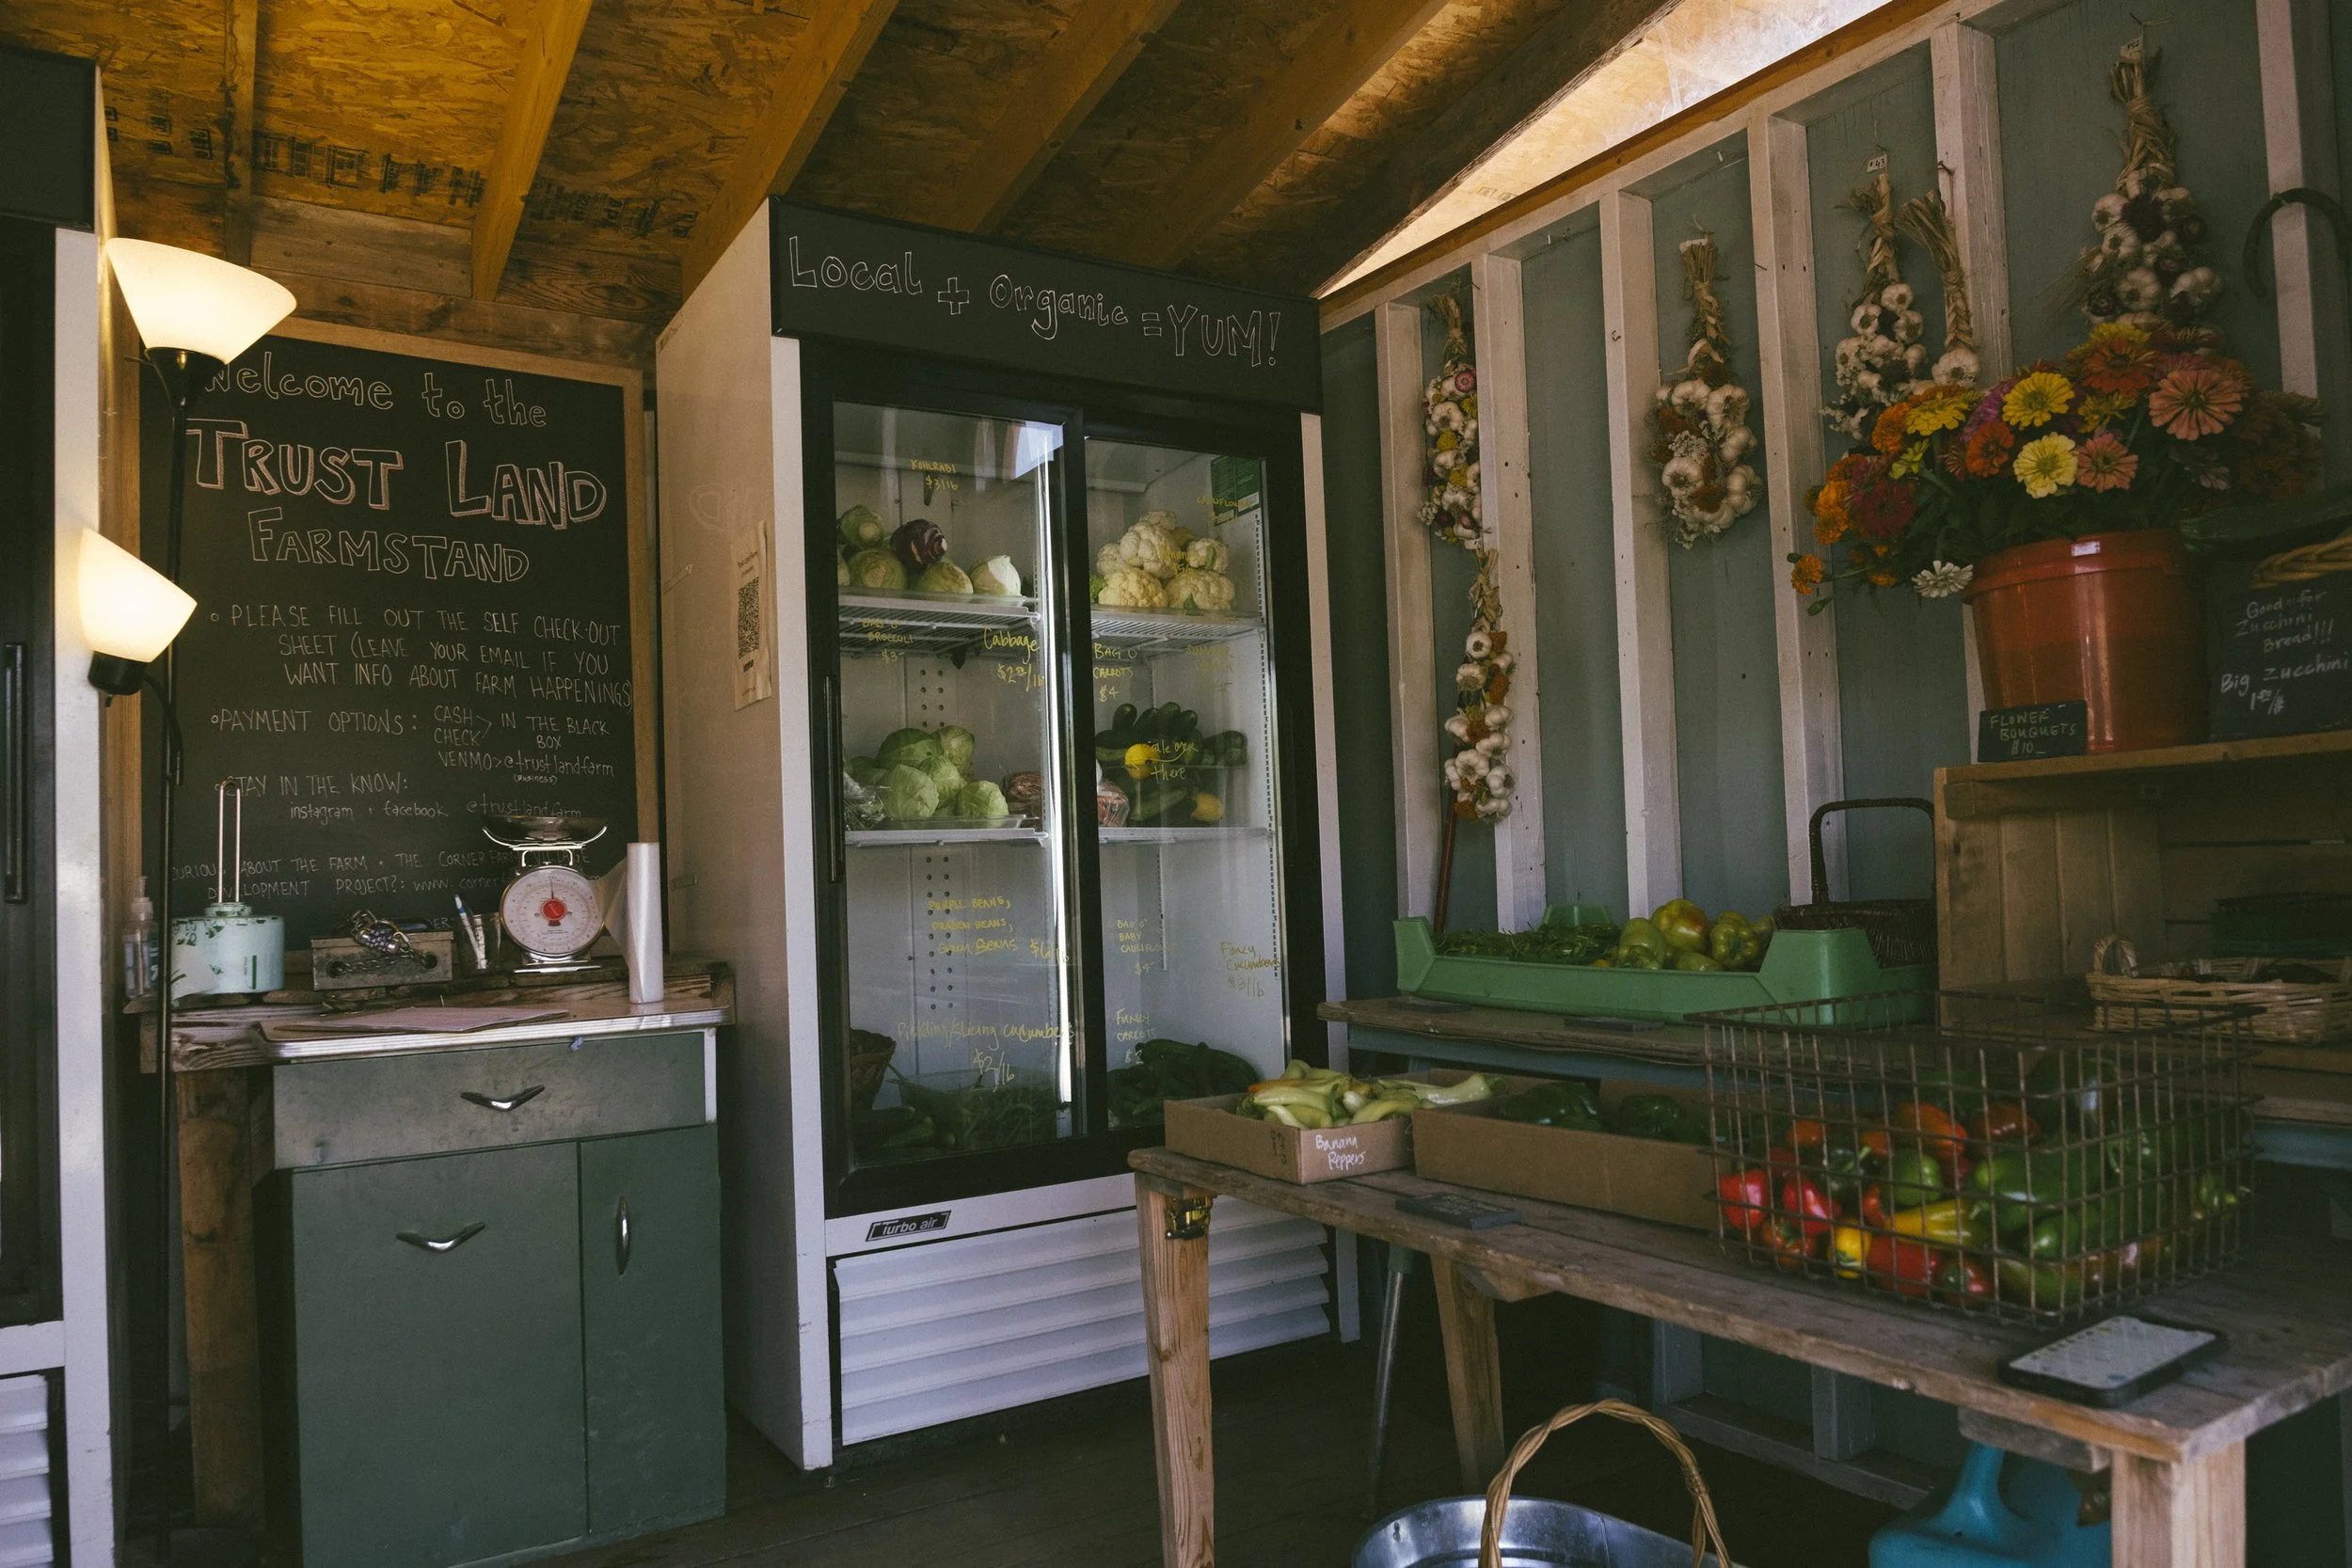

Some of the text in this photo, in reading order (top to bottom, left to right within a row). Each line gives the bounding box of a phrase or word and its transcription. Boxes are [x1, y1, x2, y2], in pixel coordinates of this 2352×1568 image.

[788, 235, 923, 295] Local
[989, 274, 1130, 340] Organic
[421, 372, 466, 419] to
[483, 378, 548, 428] the
[185, 418, 608, 531] TRUST LAND
[247, 507, 530, 584] FARMSTAND
[230, 604, 311, 627] PLEASE
[329, 605, 362, 626] FILL
[384, 609, 426, 630] OUT
[437, 610, 469, 631] THE
[484, 611, 519, 634] SELF
[2246, 596, 2283, 619] Good
[278, 631, 609, 675] SHEET (LEAVE YOUR EMAIL IF YOU
[983, 625, 1041, 665] Cabbage
[1093, 642, 1121, 659] BAG
[284, 661, 340, 686] WANT
[355, 661, 392, 687] INFO
[409, 664, 459, 689] ABOUT
[475, 672, 516, 699] FARM
[1092, 666, 1135, 679] CARROTS
[2219, 673, 2250, 697] Big
[219, 708, 312, 732] PAYMENT
[434, 705, 473, 726] CASH
[501, 711, 516, 730] IN
[526, 715, 560, 733] THE
[566, 717, 610, 736] BLACK
[1990, 710, 2050, 730] FLOWER
[434, 727, 562, 751] CHECK BOX
[1999, 722, 2077, 742] BOUQUETS
[1150, 762, 1186, 784] there
[281, 776, 297, 796] IN
[306, 775, 340, 795] THE
[290, 800, 355, 826] instagram
[383, 800, 449, 817] facebook
[171, 863, 227, 881] URIOU
[239, 859, 281, 877] ABOUT
[290, 858, 318, 873] THE
[329, 855, 368, 872] FARM
[394, 853, 422, 867] THE
[437, 851, 485, 866] CORNER
[207, 880, 310, 900] DVLOPMENT
[1119, 931, 1142, 942] BABY
[1218, 941, 1257, 957] Fancy
[1315, 1133, 1359, 1151] Banana
[1327, 1150, 1367, 1171] Peppers
[882, 1215, 939, 1236] Turbo air
